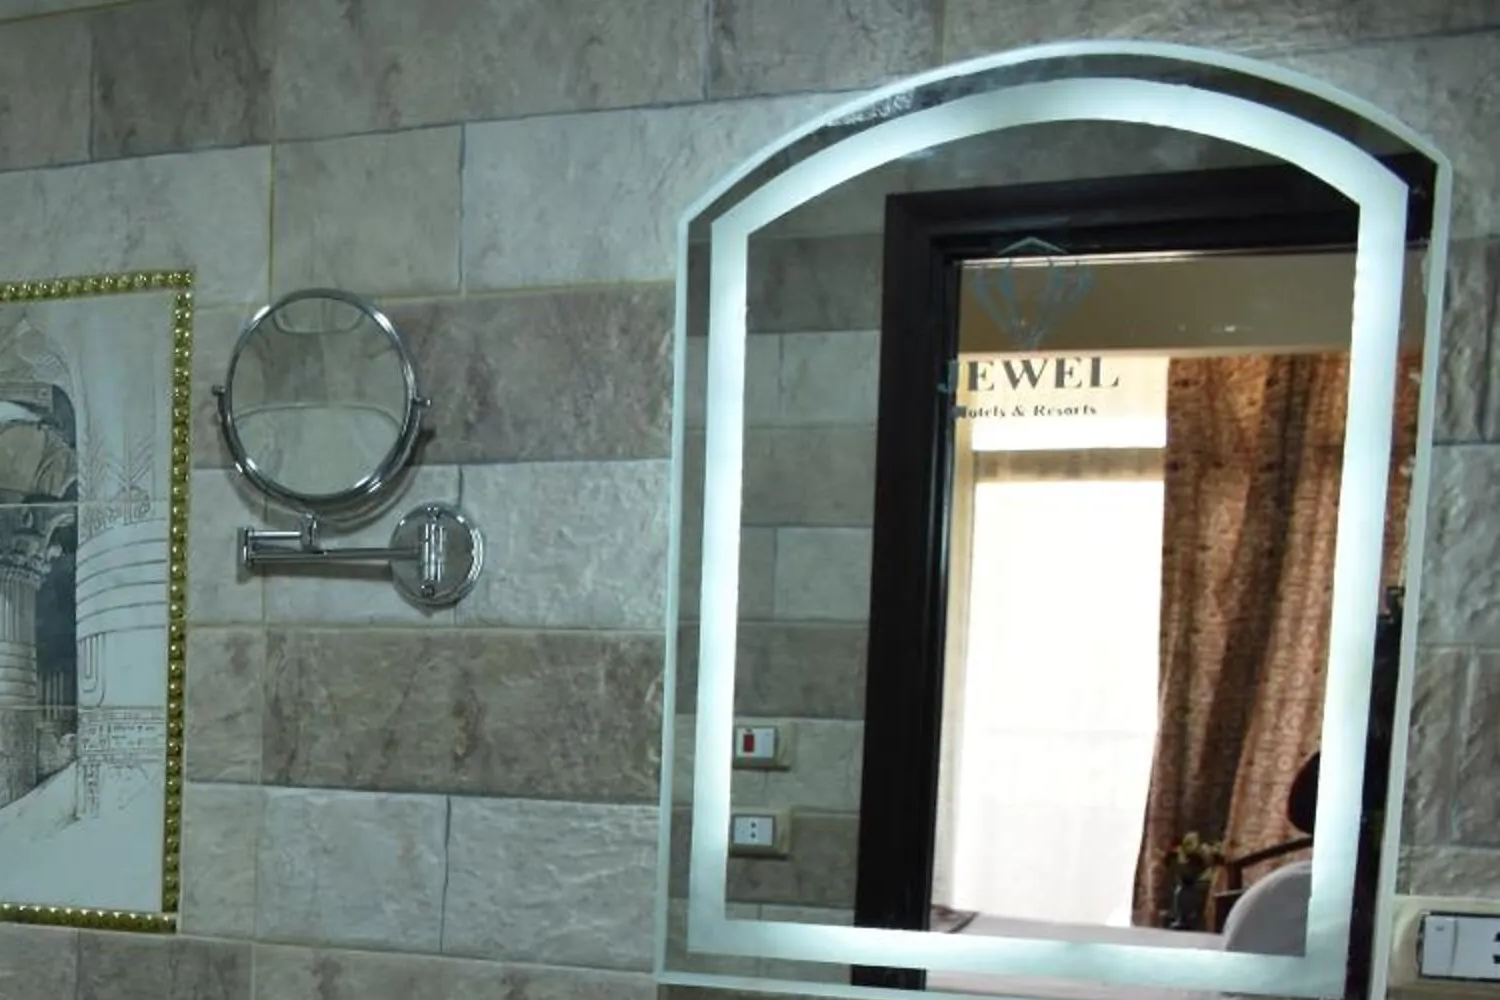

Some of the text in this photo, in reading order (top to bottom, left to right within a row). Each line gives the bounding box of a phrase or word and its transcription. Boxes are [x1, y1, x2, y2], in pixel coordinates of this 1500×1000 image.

[937, 356, 1120, 394] JEWEL
[951, 405, 1006, 418] Hotels
[1033, 404, 1098, 417] Resorts
